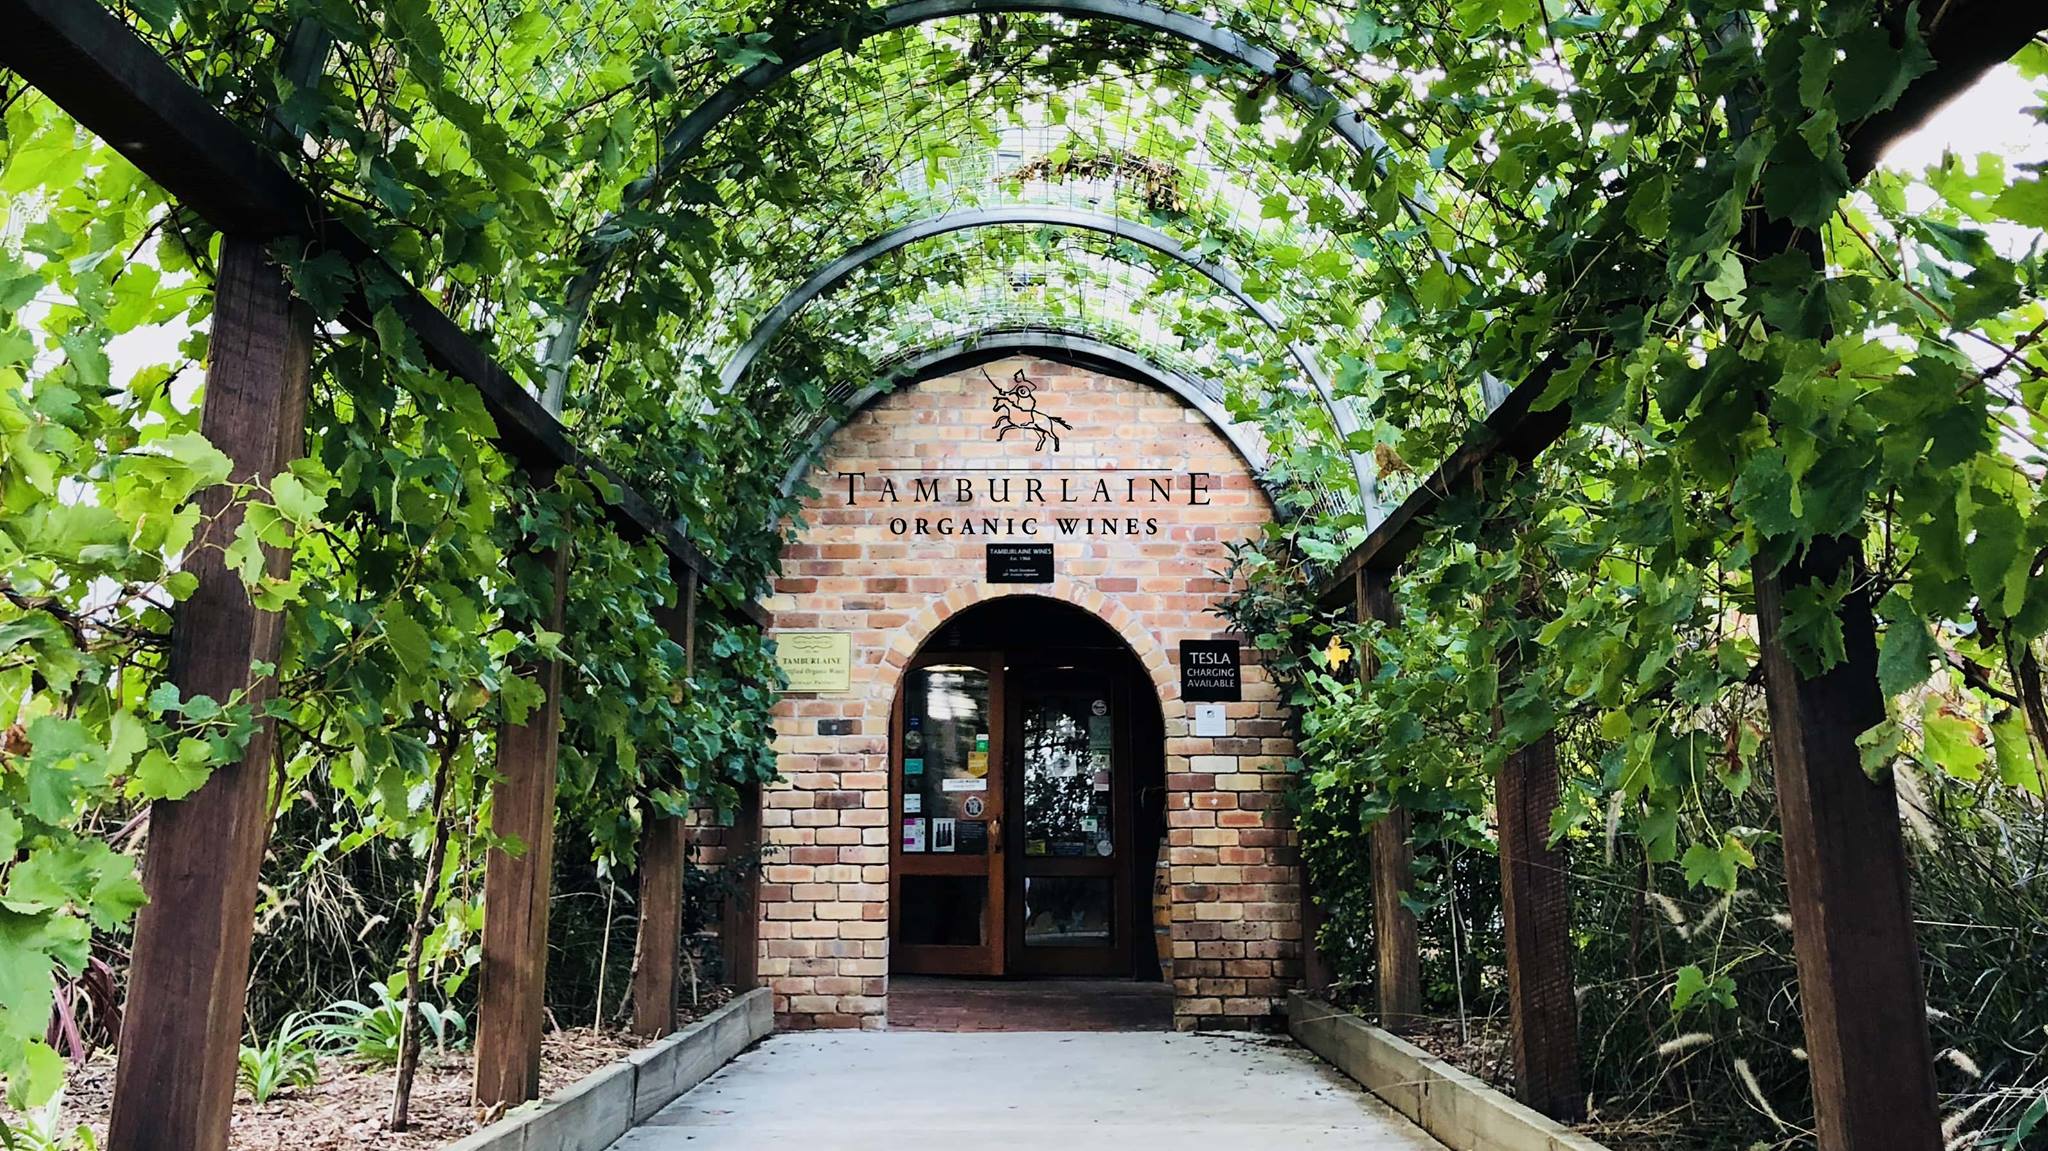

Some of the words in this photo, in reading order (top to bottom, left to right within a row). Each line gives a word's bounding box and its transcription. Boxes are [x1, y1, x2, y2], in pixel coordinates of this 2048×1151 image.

[838, 471, 1211, 506] TAMBURLAINE
[889, 517, 1038, 535] ORGANIC
[1055, 517, 1158, 535] WINES
[783, 657, 841, 665] TAMBURLAINE
[1189, 652, 1231, 665] TESLA
[1187, 668, 1235, 677] CHARGING
[1187, 679, 1235, 688] AVAILABLE
